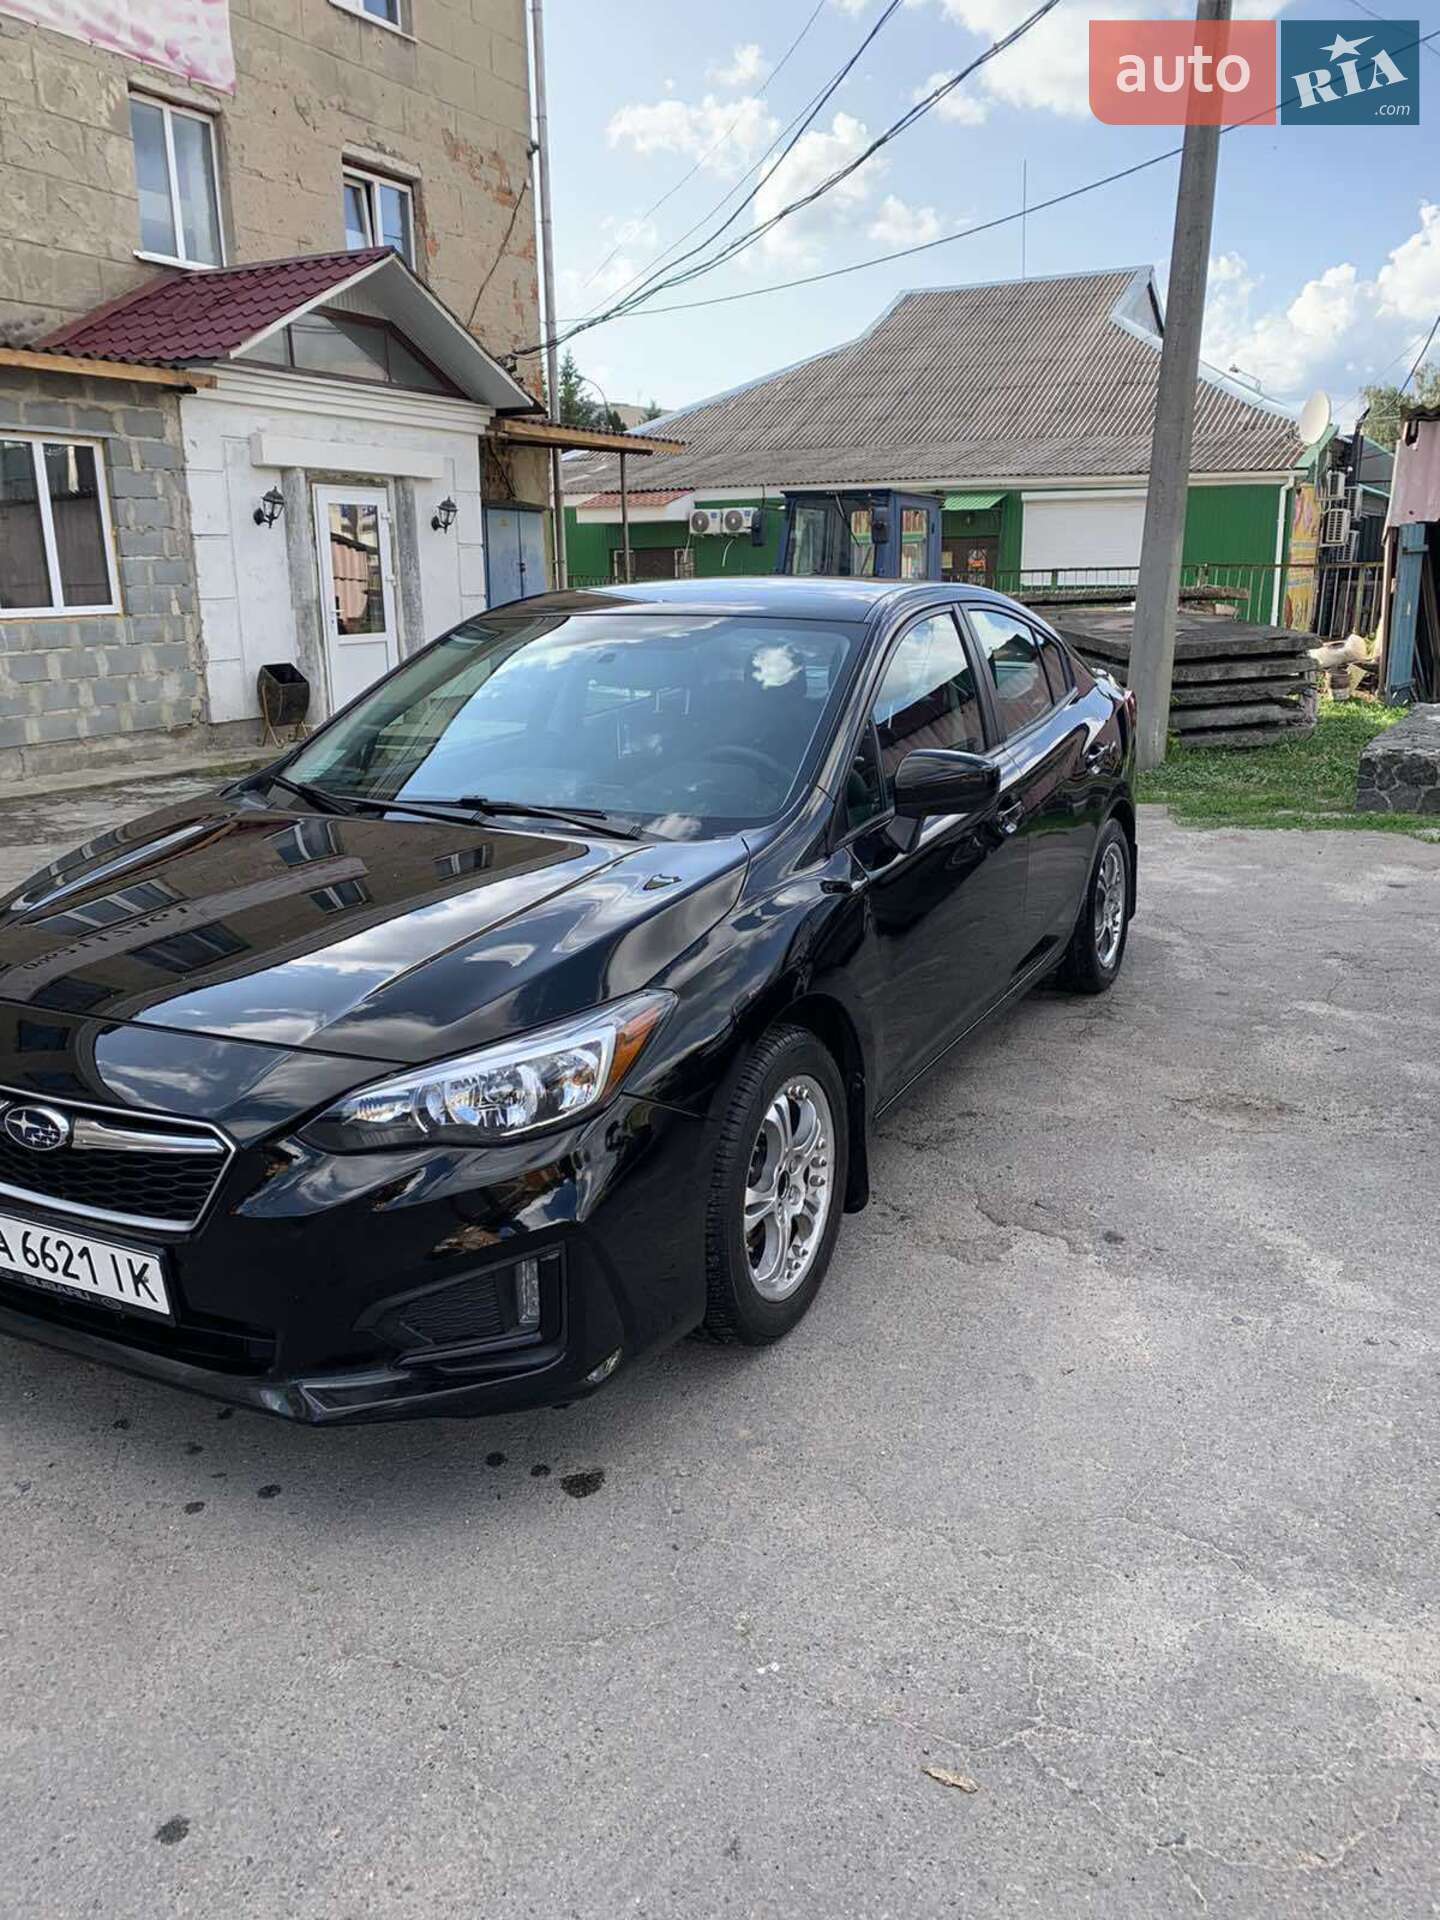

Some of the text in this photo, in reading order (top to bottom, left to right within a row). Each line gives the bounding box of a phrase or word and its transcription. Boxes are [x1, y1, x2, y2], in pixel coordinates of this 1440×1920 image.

[21, 1230, 99, 1285] 6621
[110, 1253, 159, 1303] IK
[22, 1274, 91, 1302] SUBARU
